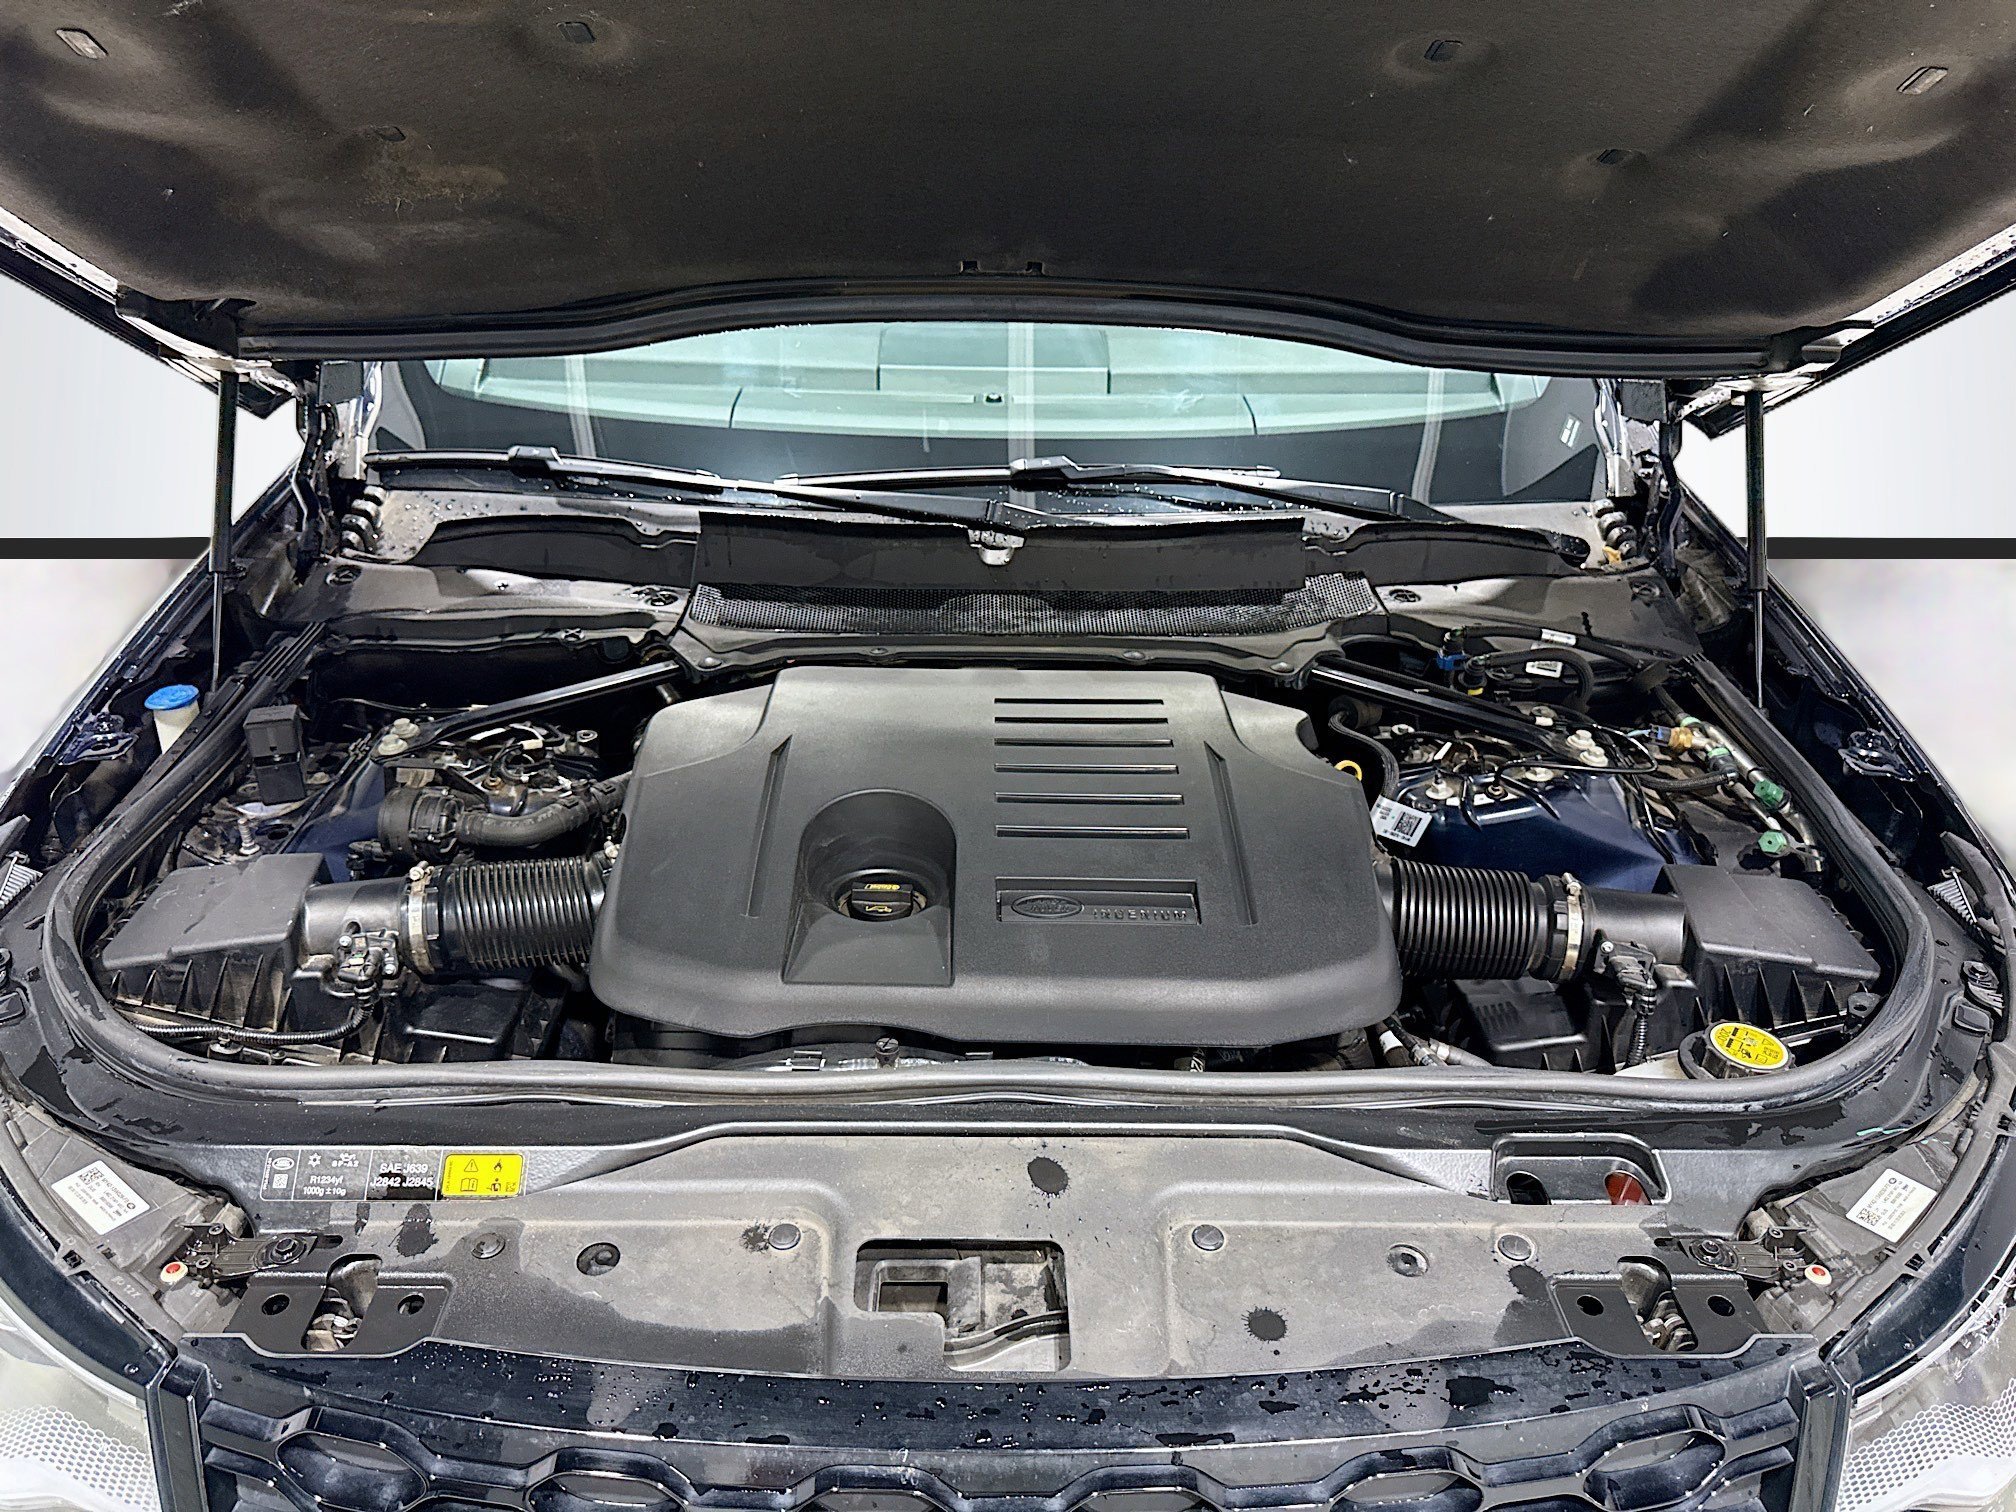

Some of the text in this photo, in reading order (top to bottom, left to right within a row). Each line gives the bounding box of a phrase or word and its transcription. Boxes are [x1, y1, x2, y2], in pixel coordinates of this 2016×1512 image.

[380, 1162, 429, 1174] SAE J639
[309, 1175, 344, 1186] R1234yf
[370, 1176, 435, 1188] J2842 J2845
[303, 1186, 325, 1197] 1000g
